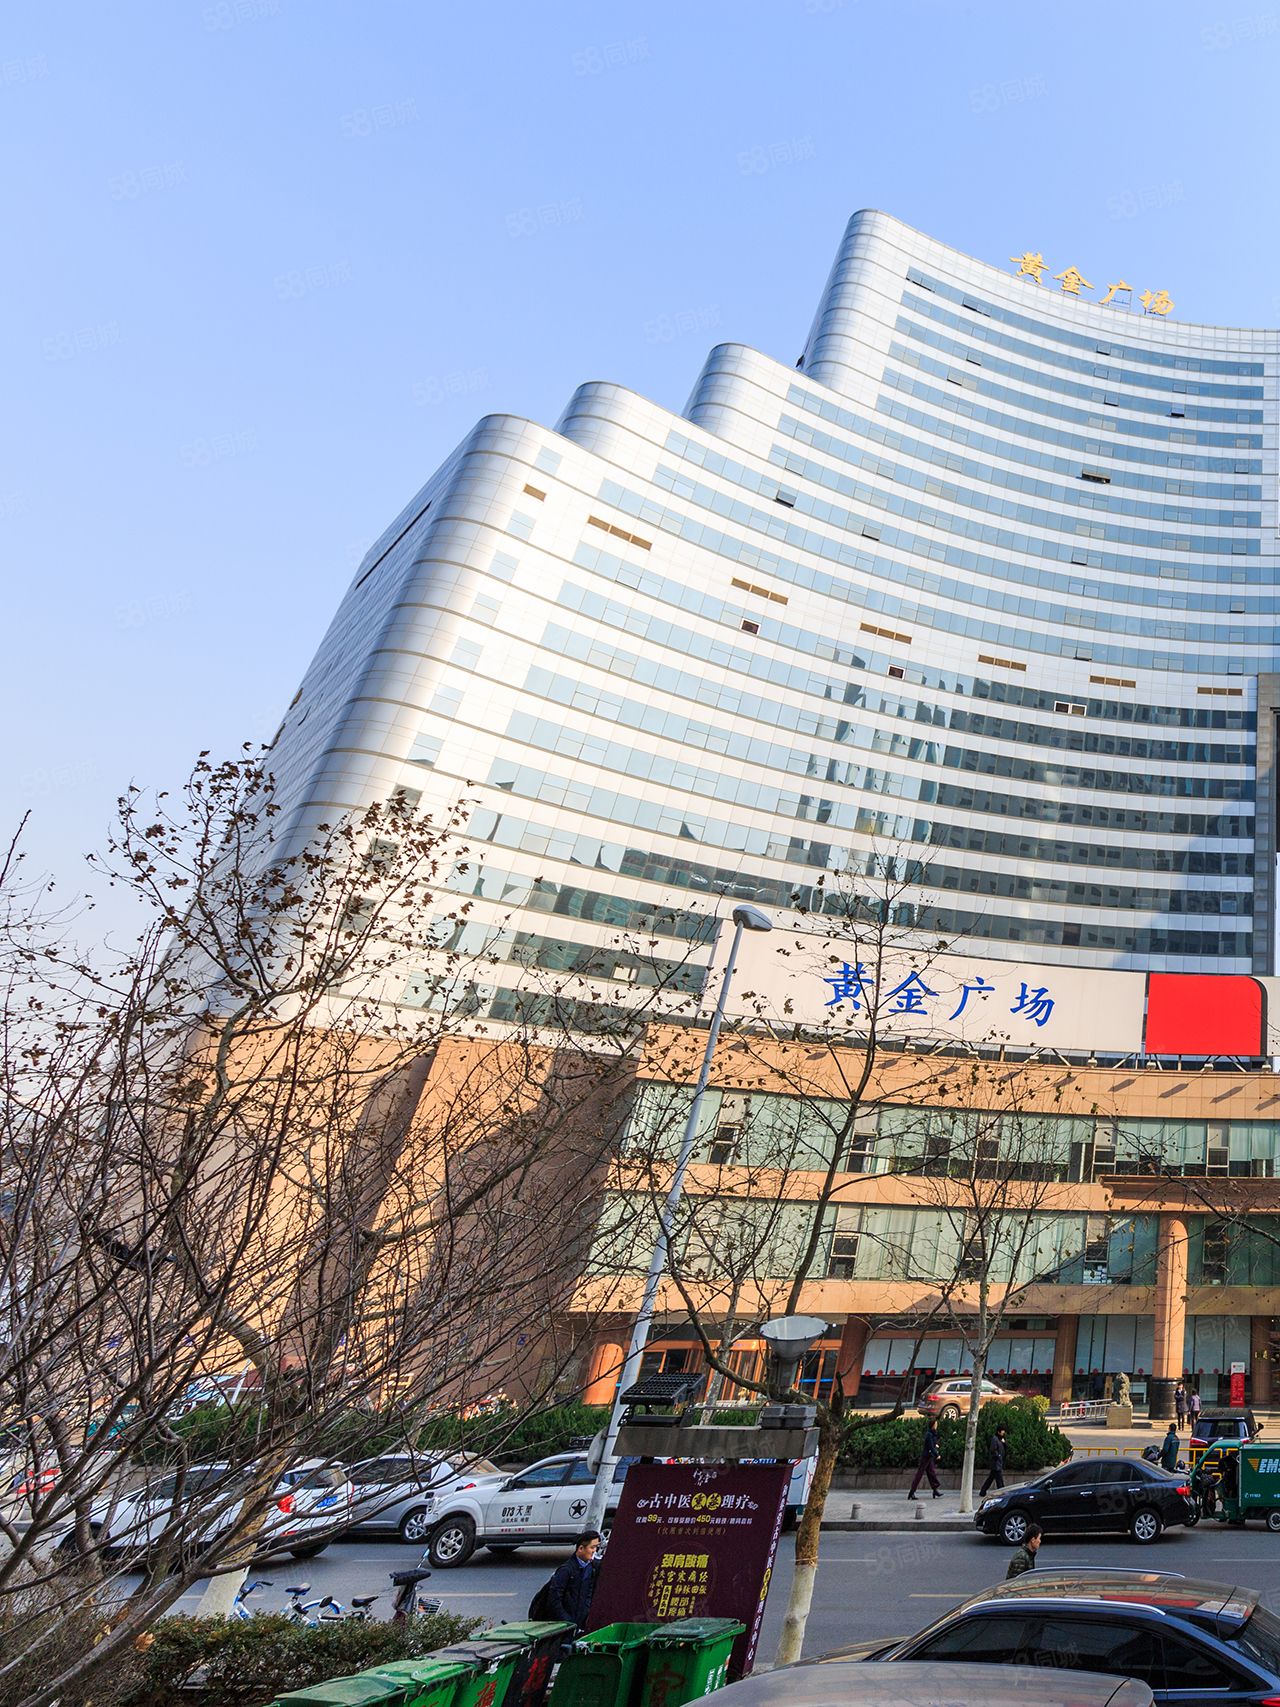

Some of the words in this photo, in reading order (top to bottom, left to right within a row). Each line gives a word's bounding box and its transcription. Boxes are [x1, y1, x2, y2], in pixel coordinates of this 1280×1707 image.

[1009, 252, 1175, 315] 黄金广场
[823, 962, 1055, 1027] 黄金广场
